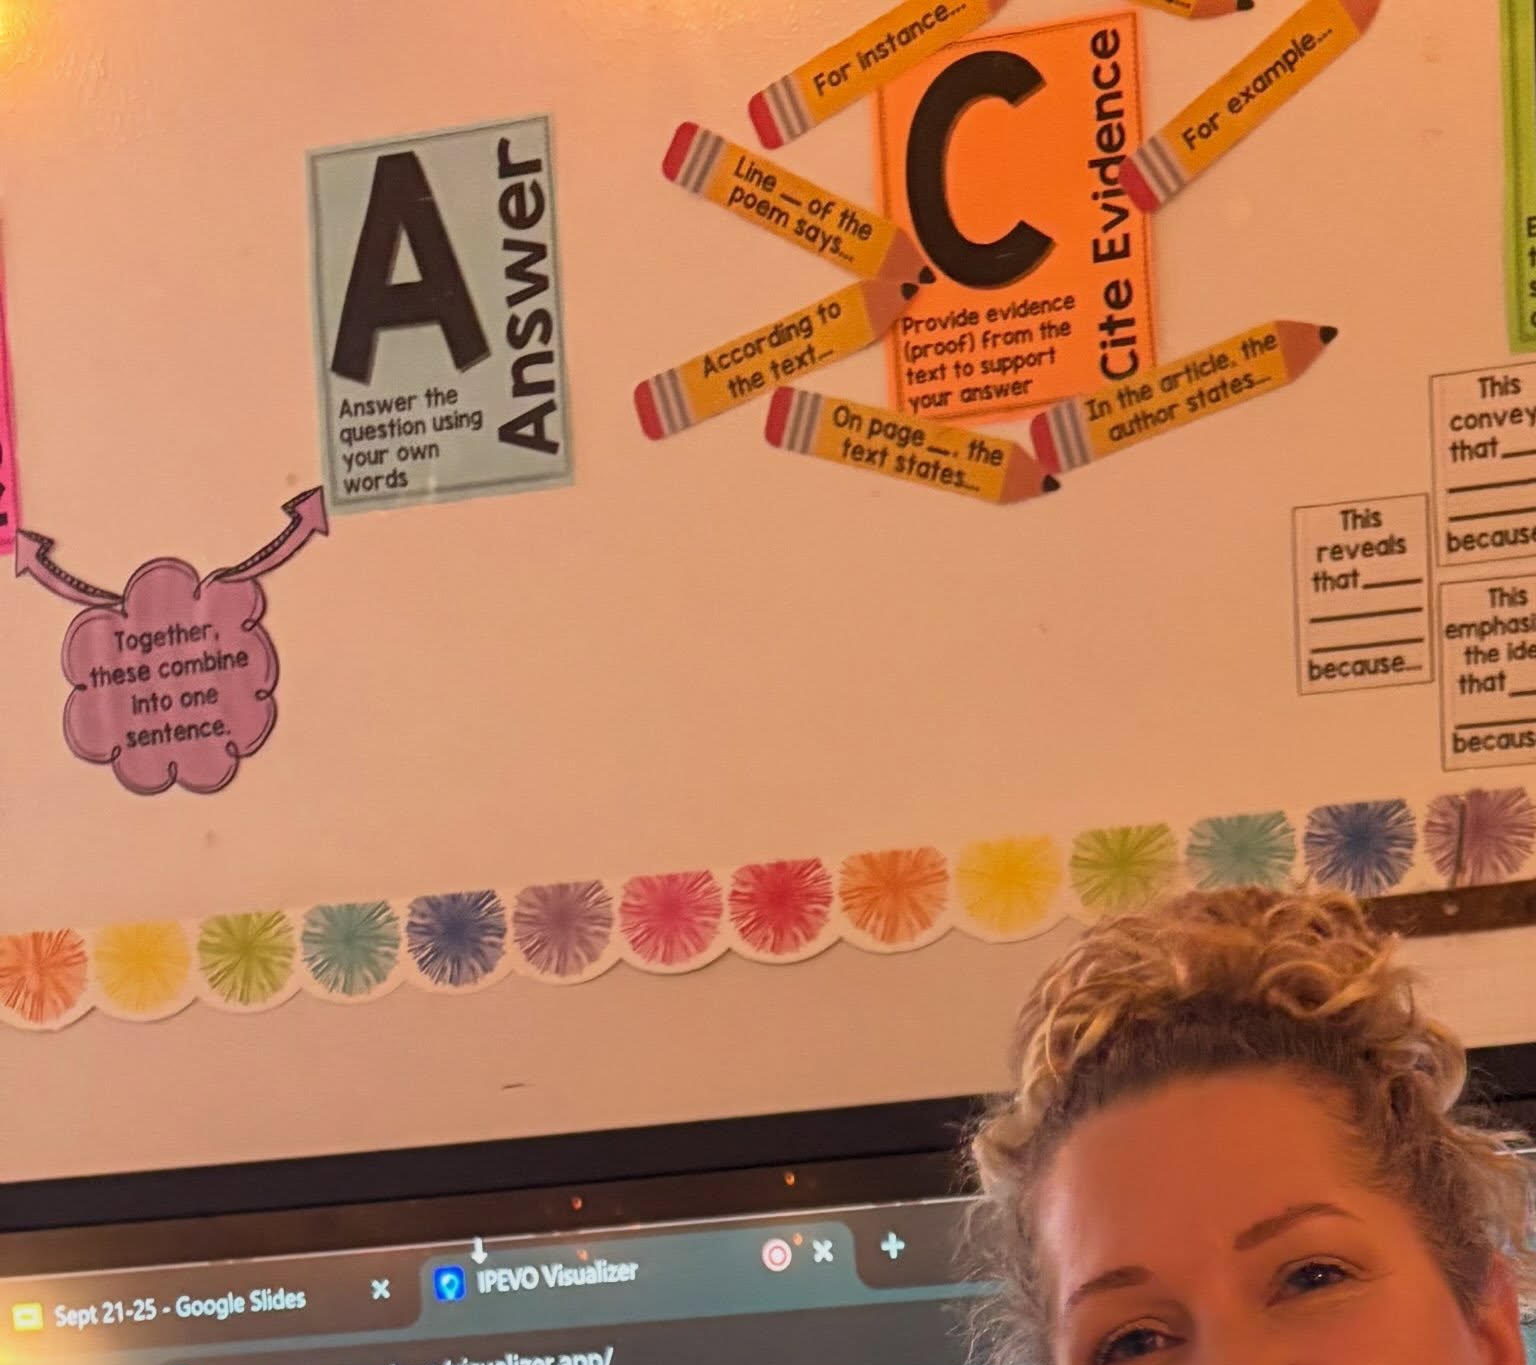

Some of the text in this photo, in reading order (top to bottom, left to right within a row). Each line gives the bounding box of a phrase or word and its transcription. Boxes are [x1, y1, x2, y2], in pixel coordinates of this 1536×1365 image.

[813, 62, 851, 96] For
[1181, 112, 1219, 150] For
[726, 185, 789, 228] poem
[733, 155, 872, 240] Line the
[1088, 28, 1139, 381] Cite Evidence
[330, 151, 491, 385] A
[498, 137, 560, 455] Answer
[902, 295, 1075, 335] Provide evidence
[703, 315, 813, 378] According
[904, 320, 1071, 364] (proof) from the
[727, 371, 766, 398] the
[905, 346, 1056, 385] text support
[1116, 384, 1153, 409] the
[1240, 334, 1277, 360] the
[338, 387, 458, 419] Answer the
[908, 379, 1033, 414] your answer
[339, 410, 483, 447] question using
[1108, 403, 1180, 441] author
[342, 443, 439, 473] your own
[841, 437, 889, 468] text
[866, 417, 1004, 466] page the
[343, 467, 408, 494] words
[1316, 534, 1407, 563] reveals
[89, 648, 249, 688] these combine
[1463, 645, 1500, 665] the
[131, 687, 218, 715] into one
[126, 719, 231, 748] sentence.
[477, 1259, 638, 1293] IPEVO Visualizer
[56, 1287, 306, 1328] Sept 21-25 Google Slides
